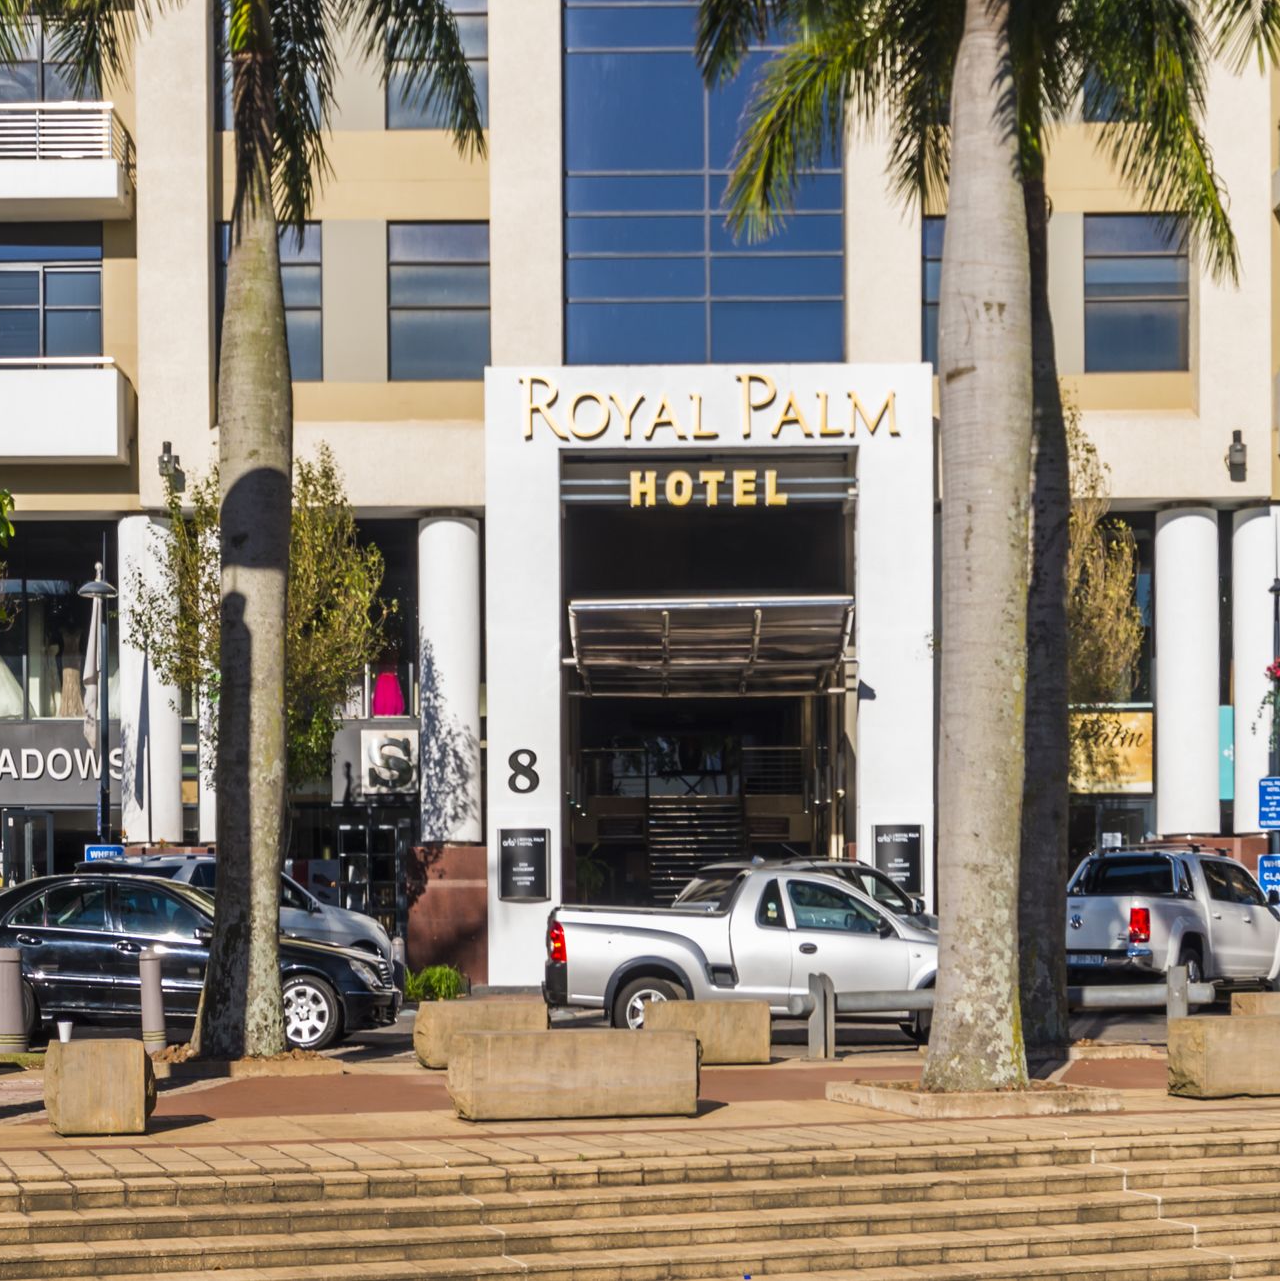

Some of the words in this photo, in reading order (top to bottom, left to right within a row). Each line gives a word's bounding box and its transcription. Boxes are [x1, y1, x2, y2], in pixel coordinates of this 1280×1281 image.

[519, 375, 719, 442] ROYAL
[736, 373, 901, 439] PALM
[629, 470, 788, 507] HOTEL
[368, 735, 414, 789] S
[508, 748, 540, 794] 8
